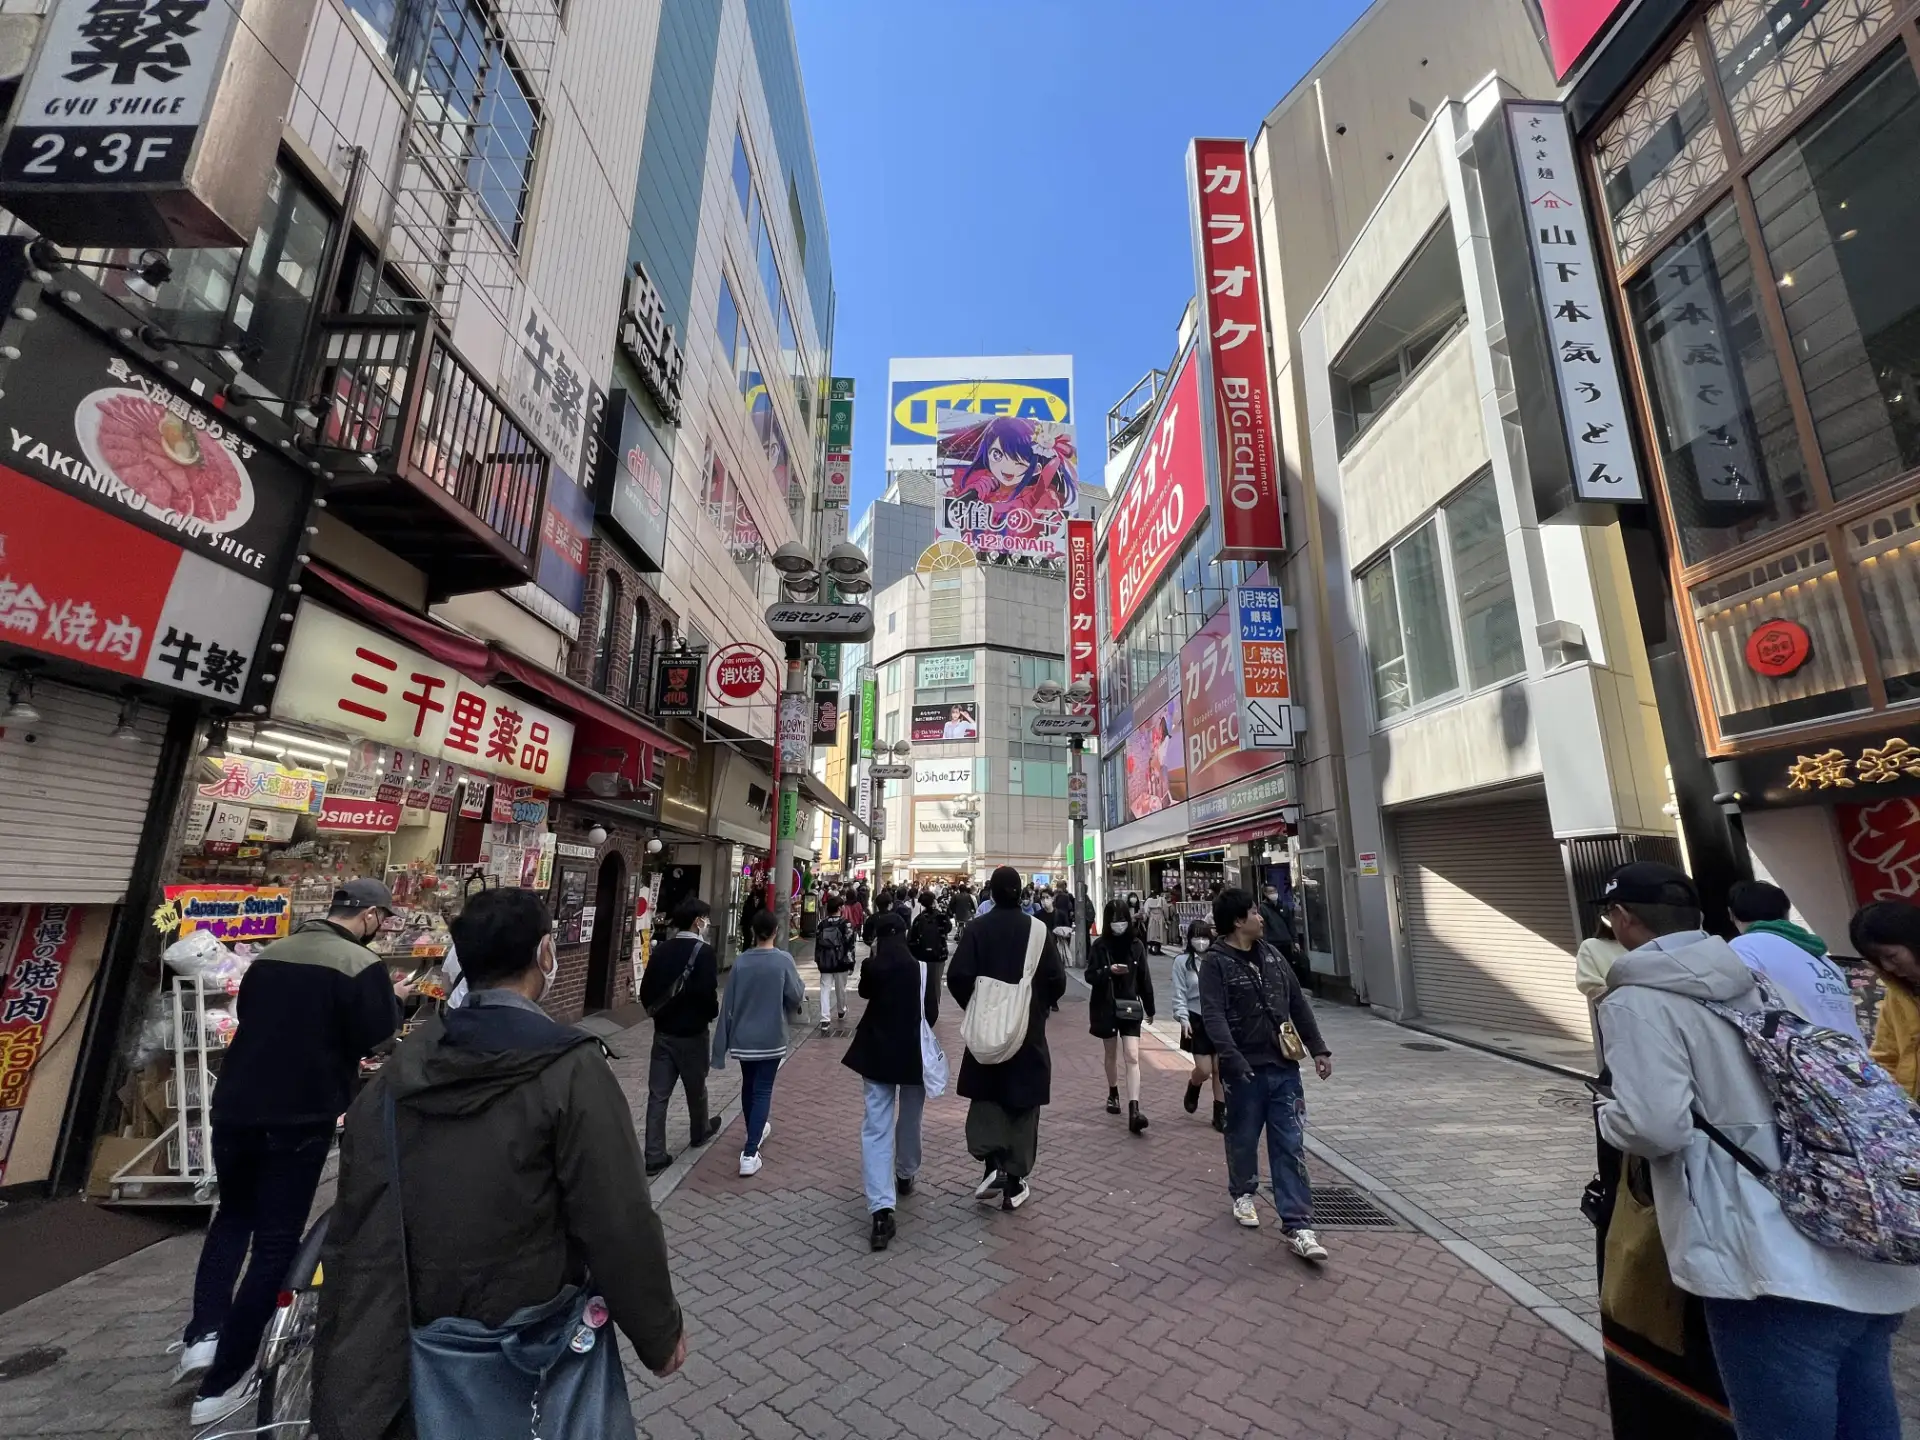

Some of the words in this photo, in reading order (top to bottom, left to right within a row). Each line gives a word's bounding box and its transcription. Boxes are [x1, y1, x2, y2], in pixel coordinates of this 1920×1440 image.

[44, 97, 95, 116] GYU
[106, 96, 187, 115] SHIGE
[1204, 165, 1256, 352] カラオケ
[1540, 225, 1623, 485] 山下本気うどん
[106, 356, 257, 460] 食べ放題あります
[1222, 376, 1250, 427] BIG
[1117, 403, 1178, 556] カラオケ
[1231, 435, 1259, 510] ECHO
[9, 427, 148, 512] YAKINIKU
[208, 531, 267, 570] SHIGE
[1072, 537, 1084, 562] BIG
[1119, 553, 1141, 618] BIG
[1142, 482, 1184, 567] ECHO
[1073, 565, 1087, 601] ECHO
[1255, 591, 1279, 608] 渋谷
[771, 611, 866, 624] 渋谷センター街
[1250, 610, 1272, 624] 眼科
[1242, 626, 1282, 638] クリニック
[158, 626, 248, 695] 牛繁
[1260, 647, 1284, 665] 渋谷
[721, 664, 762, 685] 消火栓
[1245, 667, 1287, 680] コンタクト
[1255, 681, 1280, 695] レンズ
[337, 647, 550, 774] 三千里薬品
[1249, 723, 1265, 734] 入口
[221, 763, 309, 801] 春の大感謝祭
[384, 773, 405, 786] POINT
[496, 783, 513, 797] TAX
[494, 799, 512, 815] FREE
[184, 899, 240, 917] Japanese
[3, 904, 69, 1023] 自慢の焼肉
